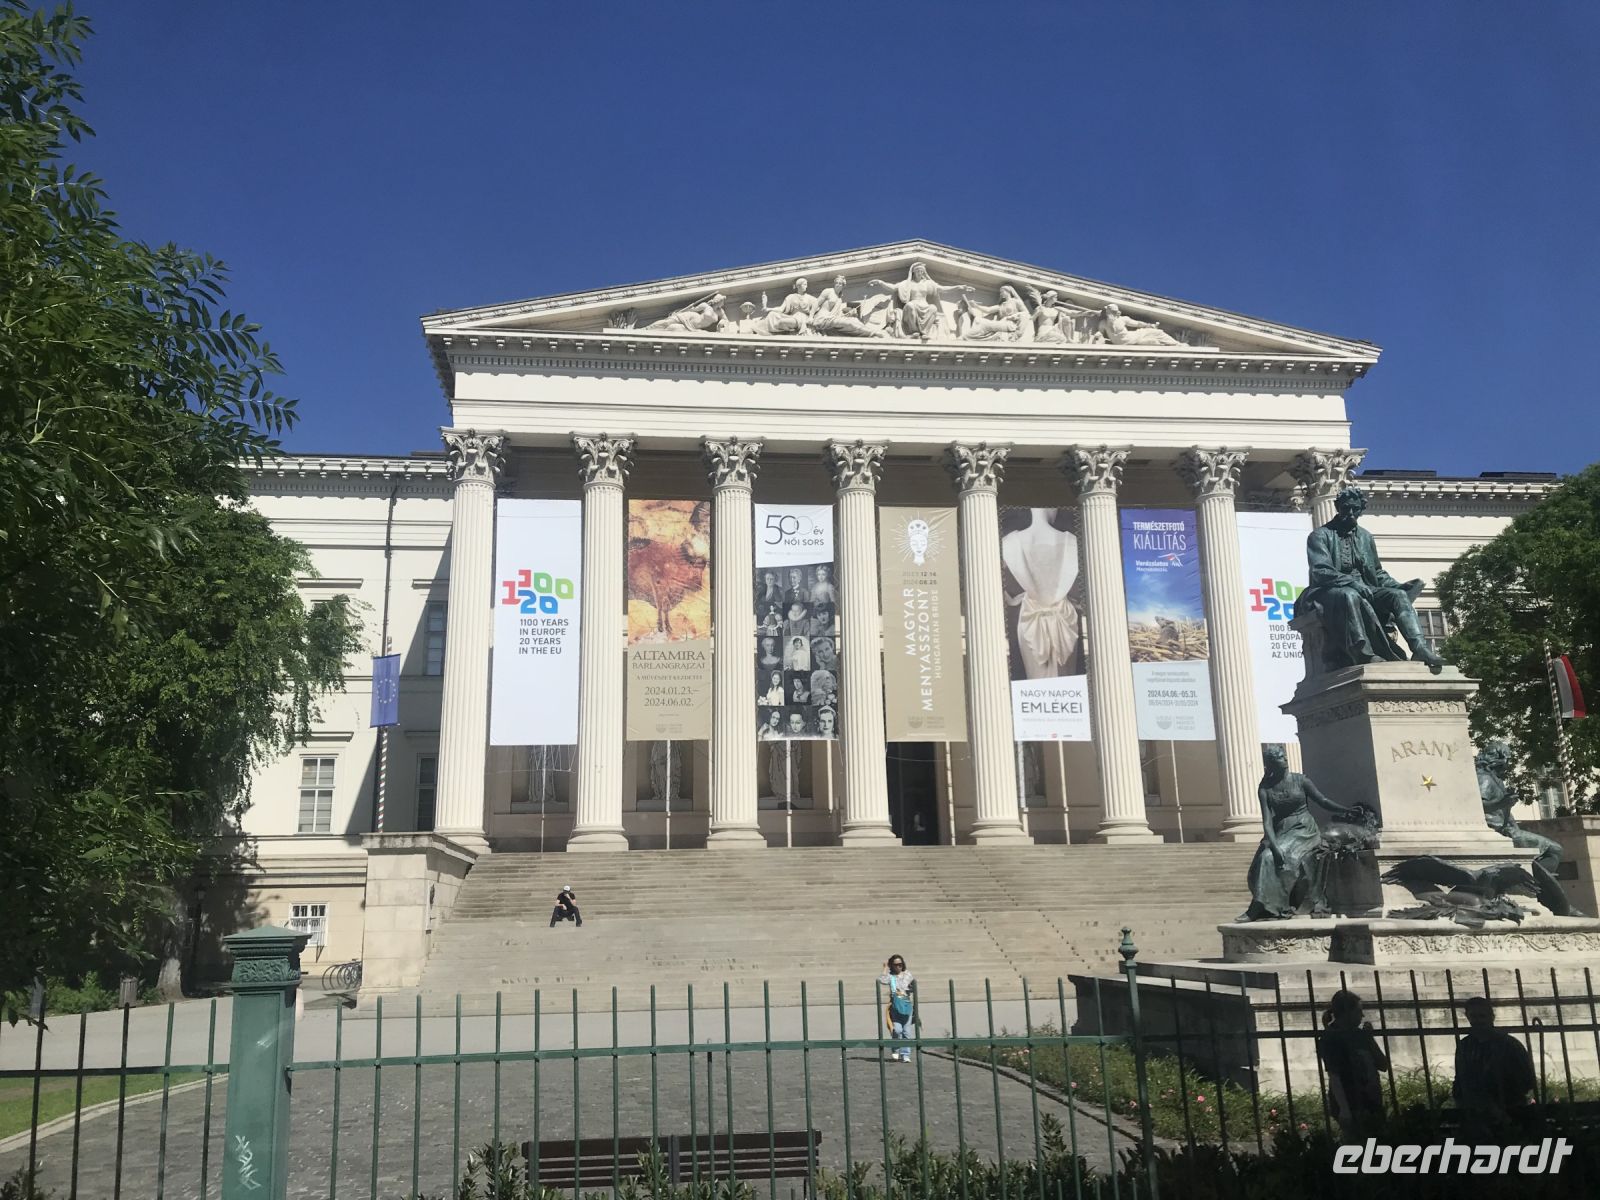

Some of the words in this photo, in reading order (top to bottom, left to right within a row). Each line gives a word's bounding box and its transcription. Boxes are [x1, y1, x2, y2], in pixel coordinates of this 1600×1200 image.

[813, 526, 824, 535] év
[1133, 521, 1185, 531] TERMÉSZETFOTÓ
[1133, 531, 1187, 551] KIÁLLÍTÁS
[520, 618, 538, 626] 1100
[541, 618, 569, 626] YEARS
[903, 588, 916, 656] MAGYAR
[519, 628, 529, 636] IN
[531, 628, 566, 636] EUROPE
[1269, 624, 1285, 632] 1100
[519, 637, 530, 645] 20
[533, 637, 561, 645] YEARS
[1271, 642, 1280, 650] 20
[1282, 640, 1297, 650] ÉVE
[519, 646, 528, 655] IN
[530, 646, 548, 655] THE
[550, 646, 562, 655] EU
[917, 588, 934, 711] MENYASSZONY
[633, 650, 705, 660] ALTAMIRA
[1271, 651, 1281, 659] AZ
[1283, 650, 1303, 659] UNIÓ
[1020, 689, 1047, 698] NAGY
[1048, 689, 1082, 698] NAPOK
[1021, 699, 1083, 714] EMLÉKEI
[1391, 740, 1459, 763] ARANY
